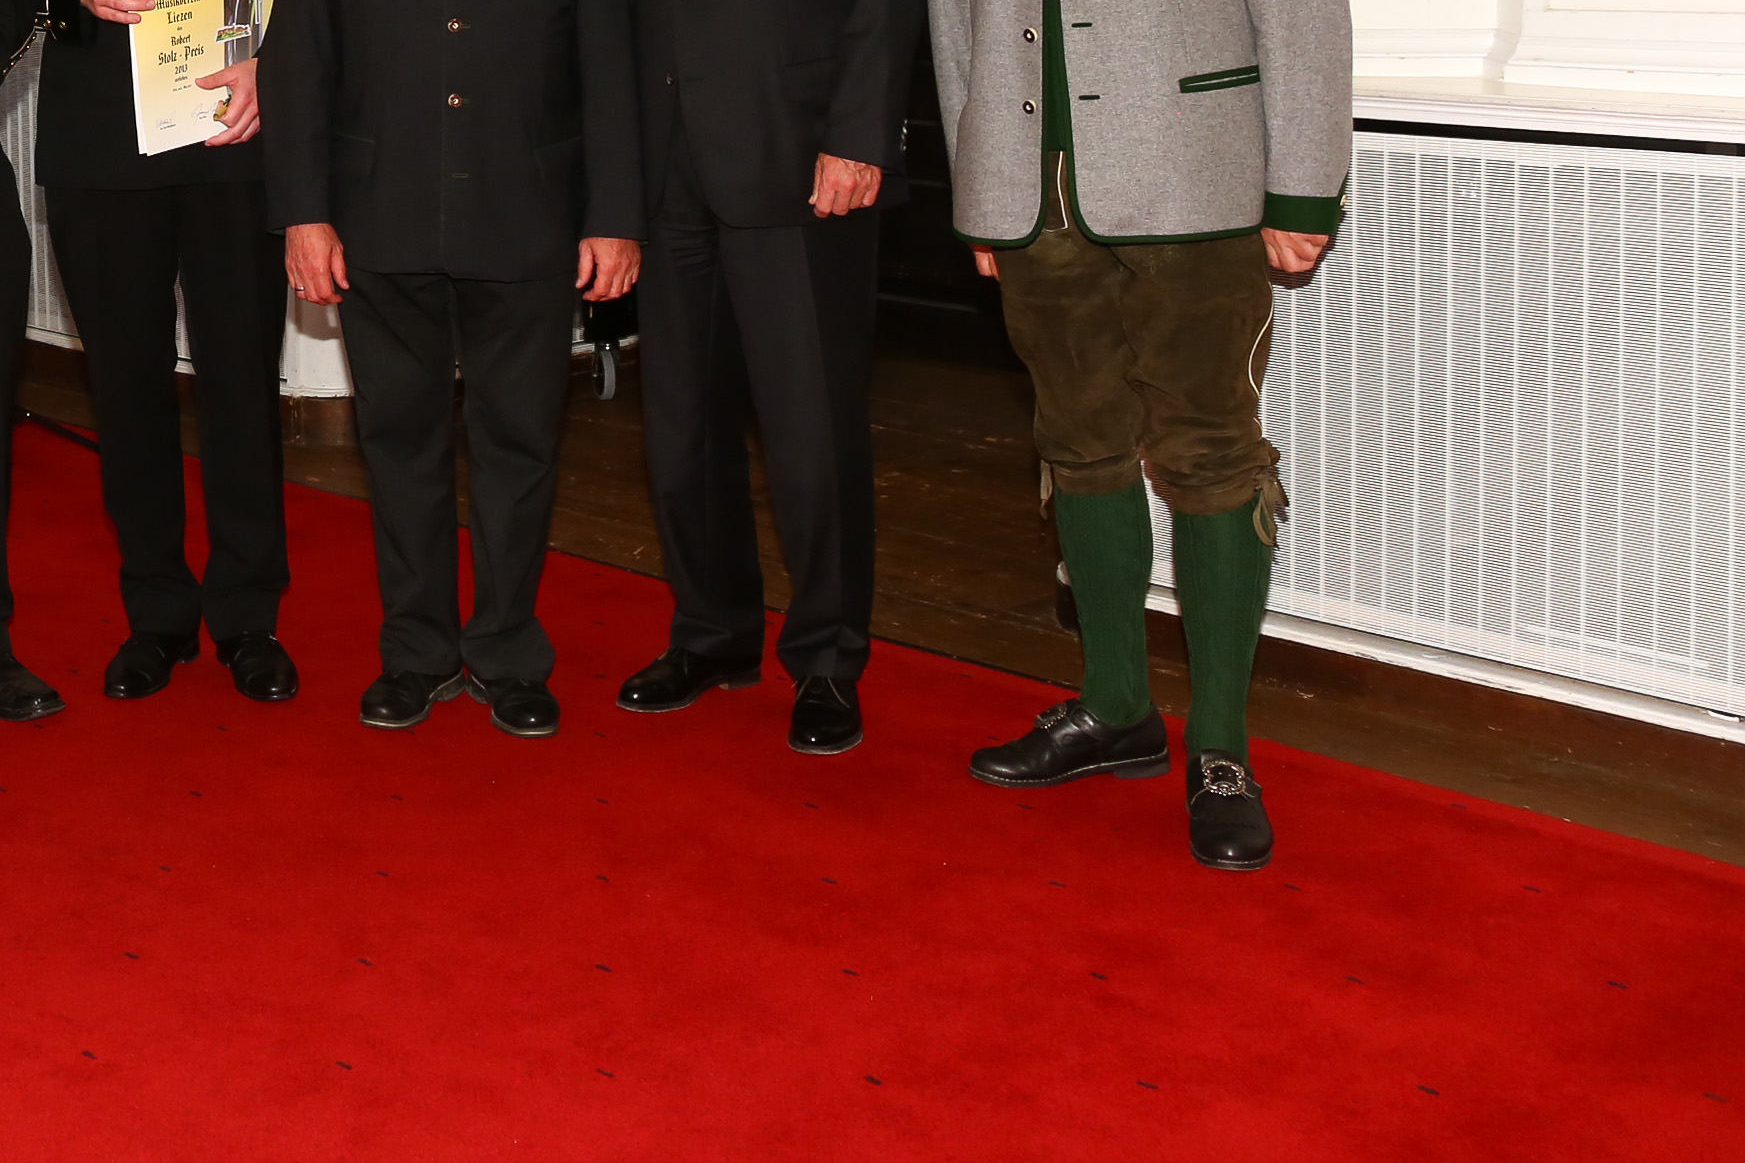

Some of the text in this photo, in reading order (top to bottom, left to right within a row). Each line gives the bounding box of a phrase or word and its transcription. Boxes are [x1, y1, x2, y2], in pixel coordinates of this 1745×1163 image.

[167, 11, 193, 24] Liezen
[171, 34, 191, 46] Robert
[158, 50, 177, 66] Stolz
[184, 44, 204, 61] Preis
[175, 64, 188, 75] 2013
